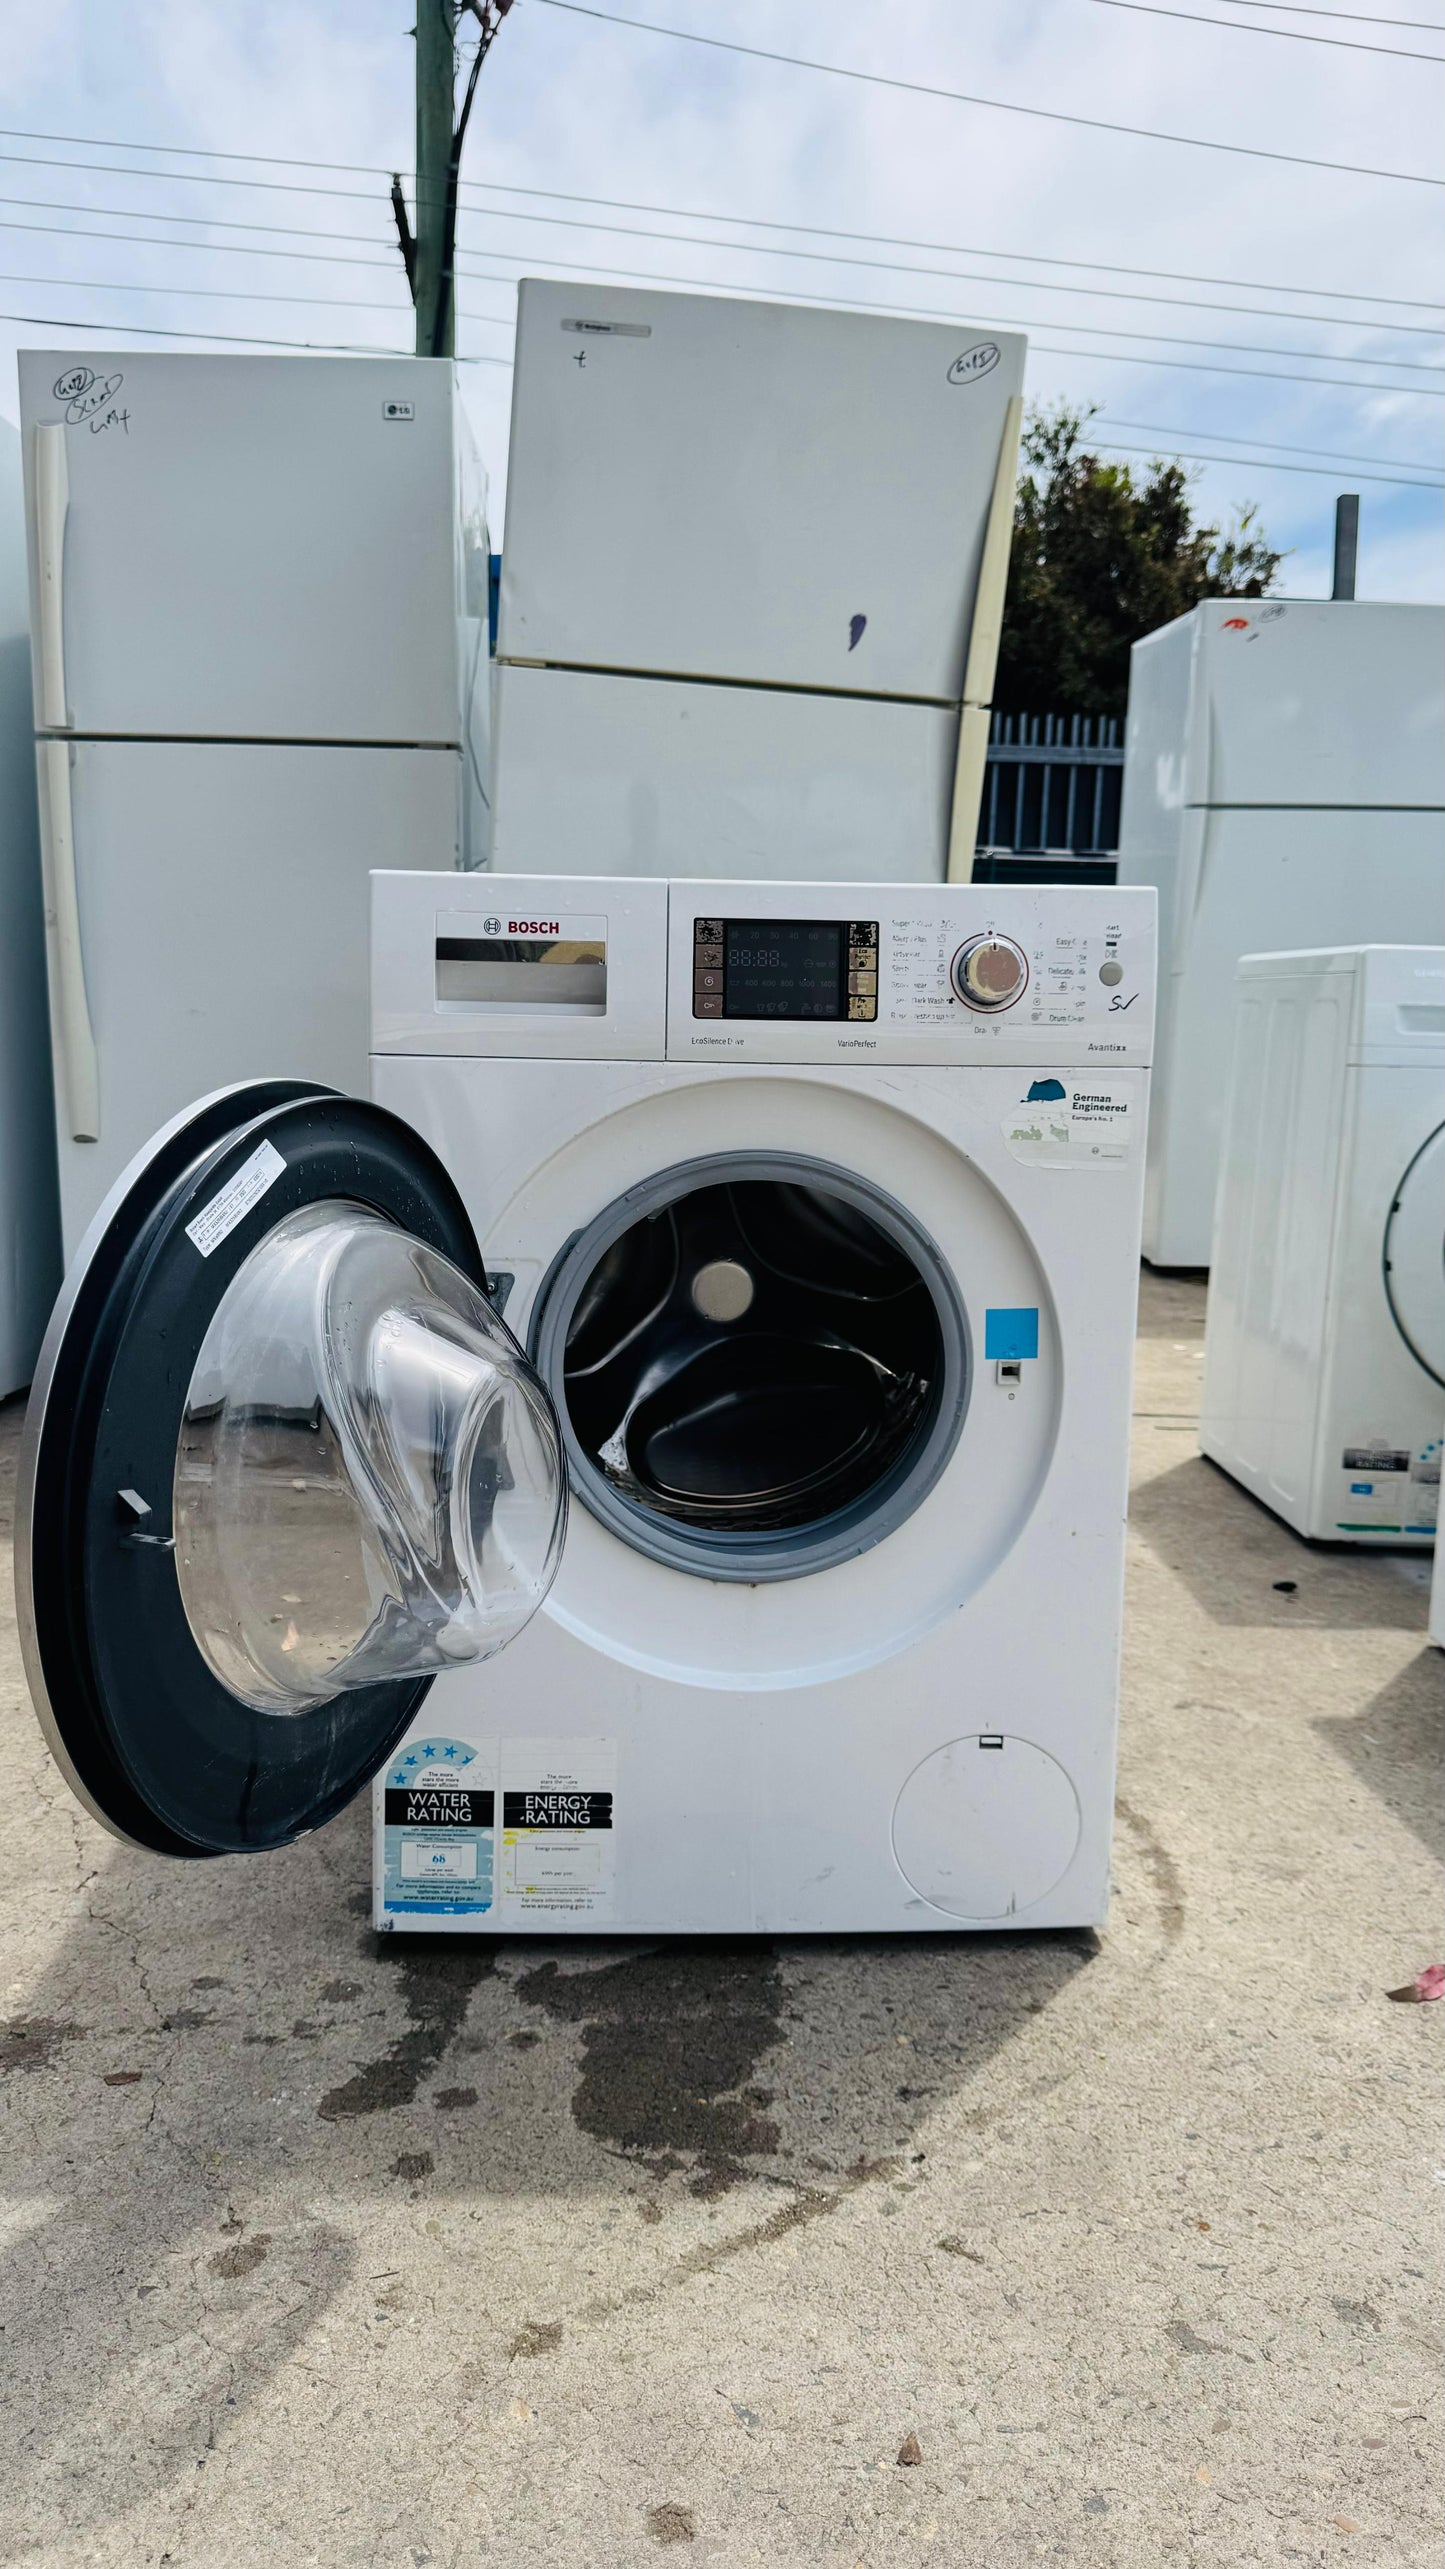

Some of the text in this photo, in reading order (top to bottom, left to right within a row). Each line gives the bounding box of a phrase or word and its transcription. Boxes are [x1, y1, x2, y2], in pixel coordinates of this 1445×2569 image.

[508, 921, 559, 934] BOSCH
[838, 1039, 877, 1049] VarioPerfect
[1088, 1043, 1126, 1052] Avantixx
[1073, 1093, 1111, 1103] German
[1072, 1102, 1127, 1112] Engineered
[409, 1792, 471, 1807] WATER
[525, 1795, 592, 1810] ENERGY
[407, 1807, 472, 1822] RATING
[525, 1810, 591, 1824] RATING
